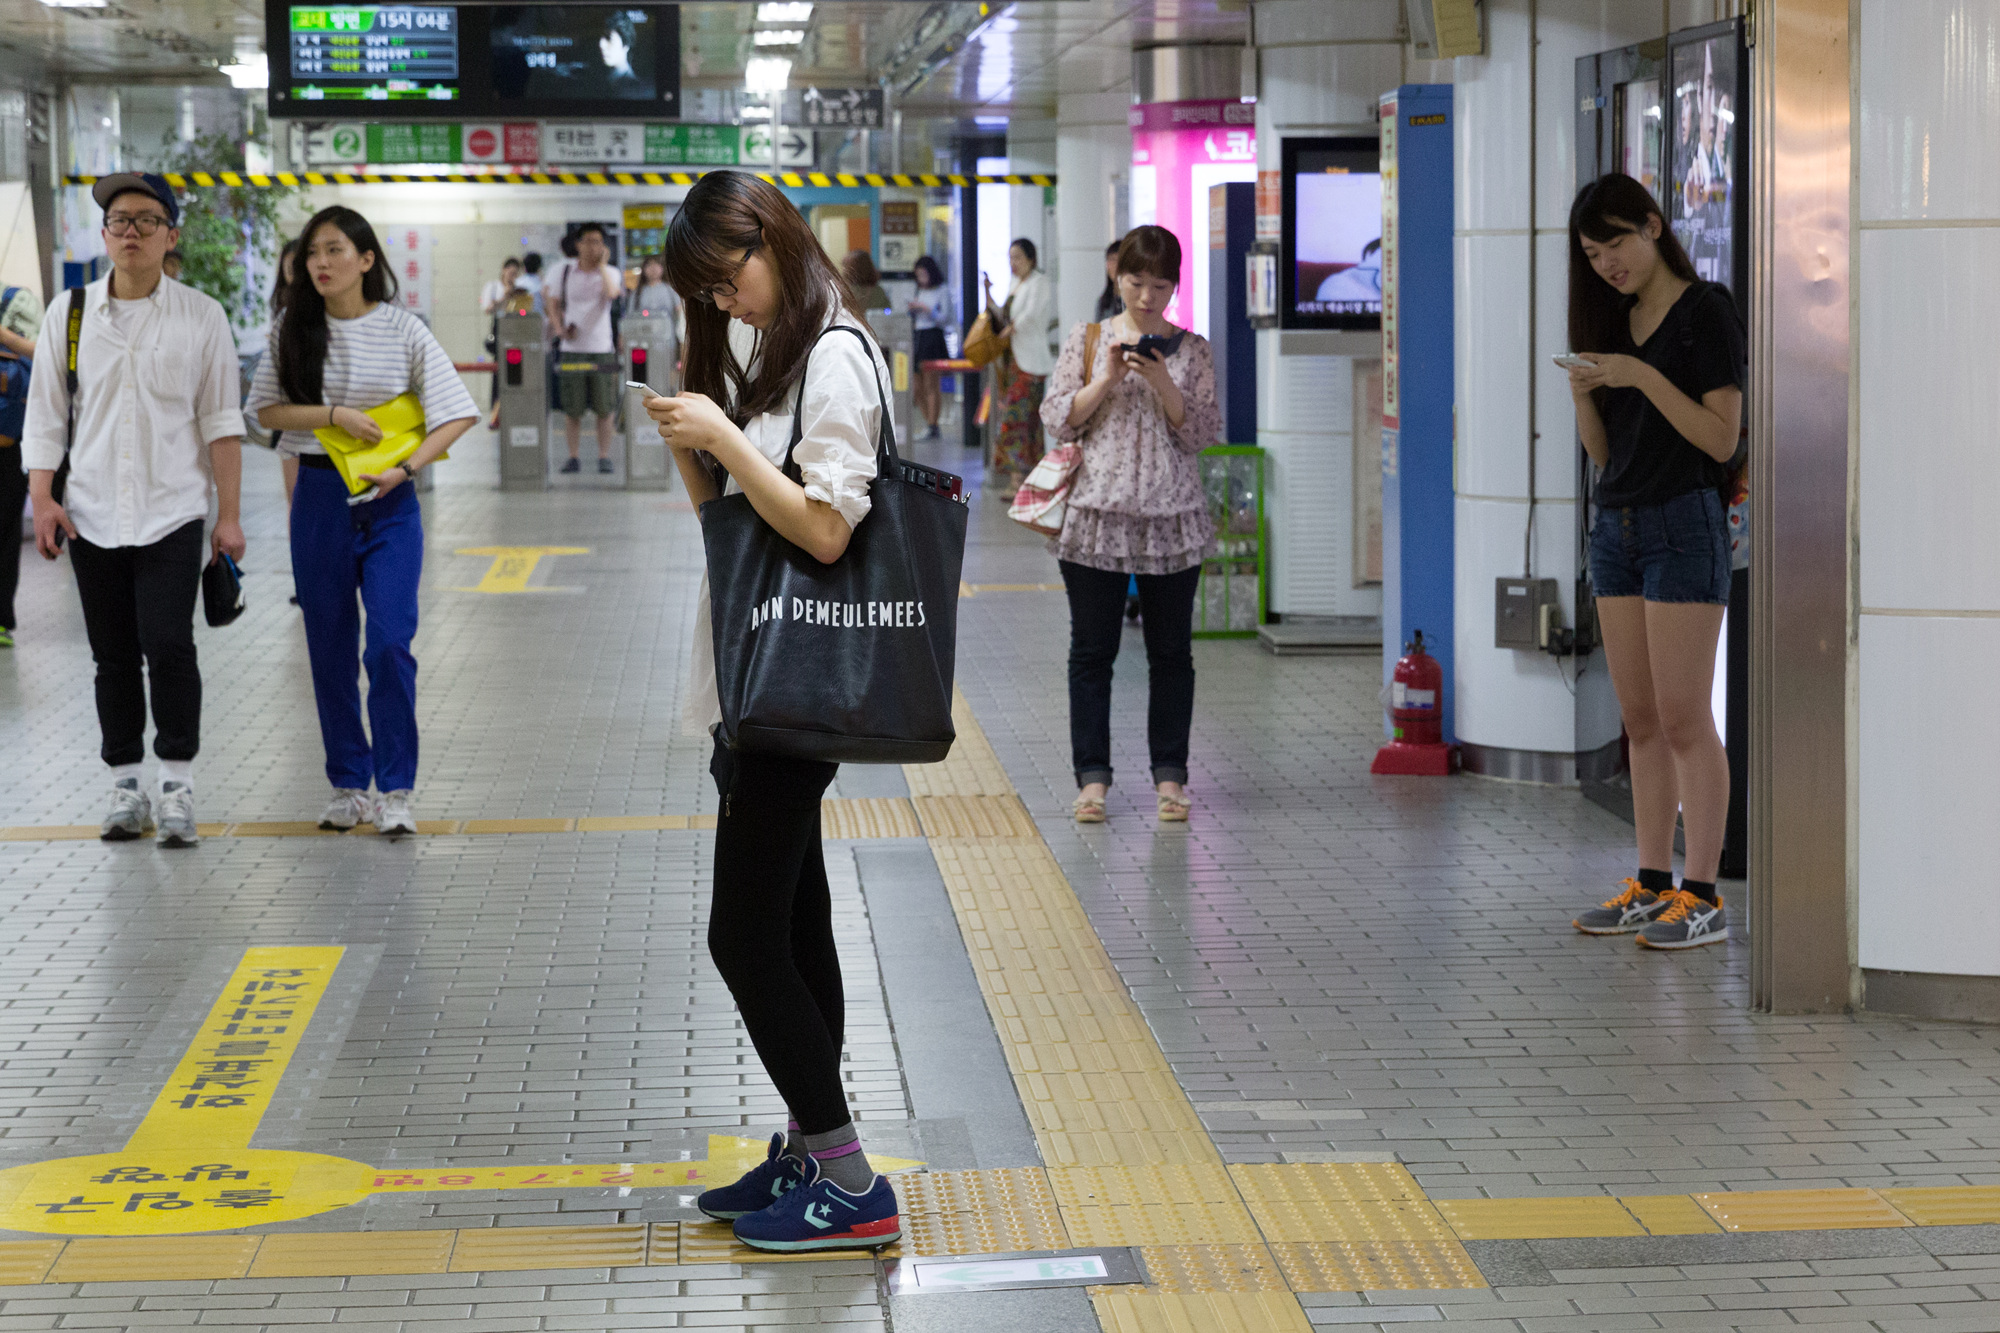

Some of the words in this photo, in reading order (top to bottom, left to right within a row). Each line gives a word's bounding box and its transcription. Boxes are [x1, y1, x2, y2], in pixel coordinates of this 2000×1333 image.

[379, 12, 412, 31] 15시
[415, 12, 452, 31] 04분
[751, 596, 784, 631] ANN
[792, 596, 926, 628] DEMEULEMEES
[89, 1163, 251, 1185] 방향
[35, 1189, 285, 1214] 출입구
